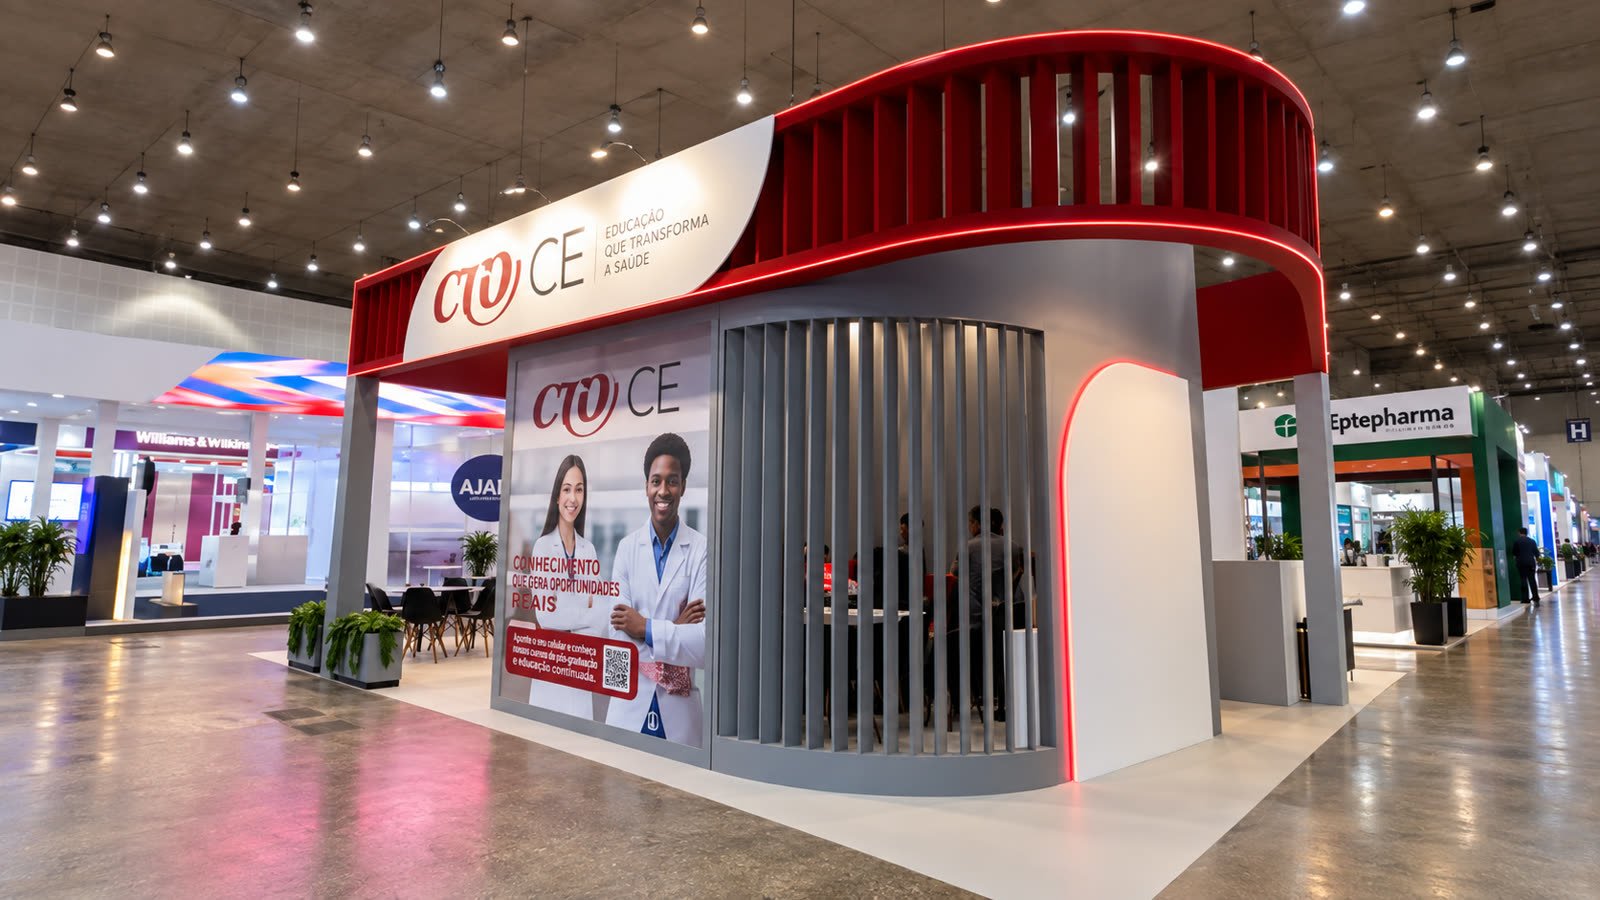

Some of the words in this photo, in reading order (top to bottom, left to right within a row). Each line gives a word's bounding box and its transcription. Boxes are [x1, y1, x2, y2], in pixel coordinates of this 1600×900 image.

[605, 208, 665, 239] EDUCAÇÃO
[604, 240, 627, 258] QUE
[630, 213, 709, 249] TRANSFORMA
[530, 226, 586, 296] CE
[604, 264, 611, 276] A
[614, 252, 650, 273] SAÚDE
[628, 361, 681, 417] CE
[1331, 407, 1454, 435] Eptepharma
[1570, 423, 1587, 439] H
[136, 431, 196, 447] Williams
[196, 436, 207, 448] &
[513, 555, 600, 576] CONHECIMENTO
[512, 574, 527, 589] QUE
[528, 575, 548, 590] GERA
[550, 577, 620, 597] OPORTUNIDADES
[511, 592, 557, 612] REAIS
[512, 657, 518, 665] e
[518, 657, 551, 673] educação
